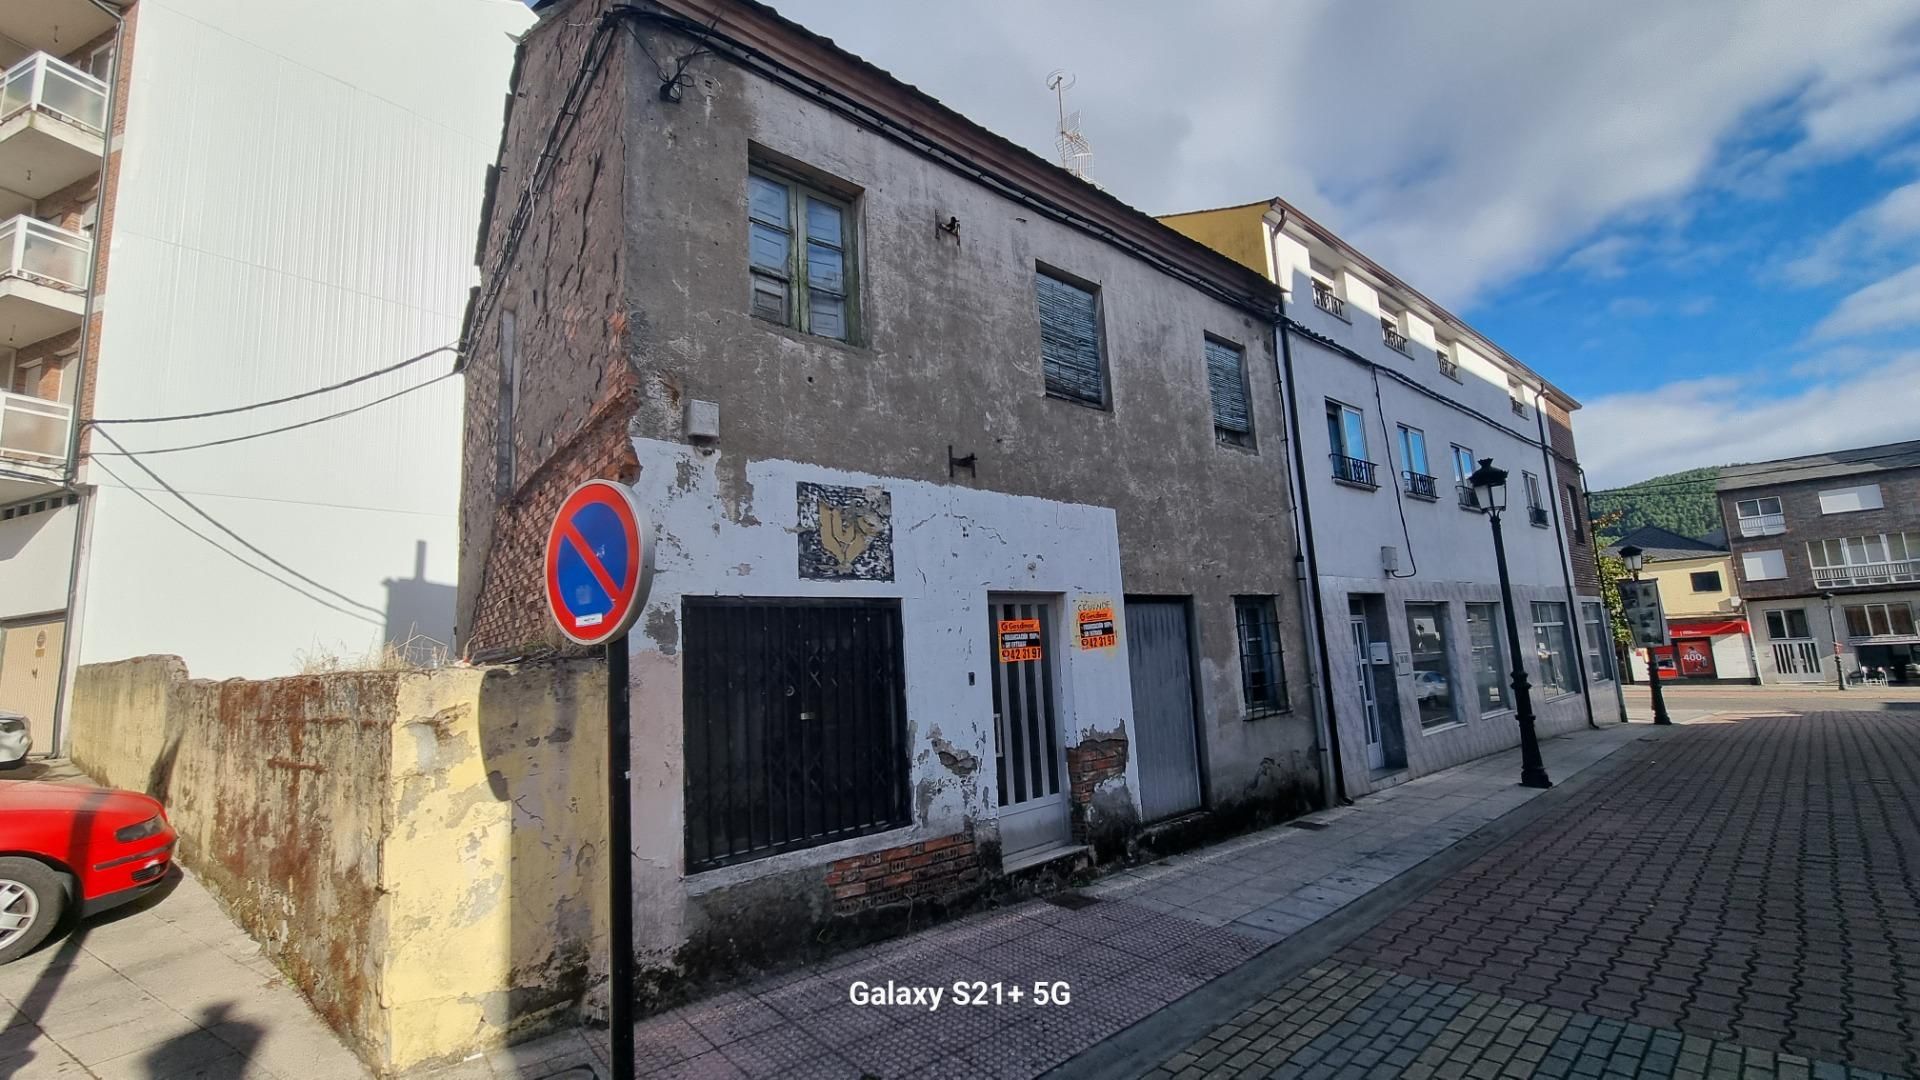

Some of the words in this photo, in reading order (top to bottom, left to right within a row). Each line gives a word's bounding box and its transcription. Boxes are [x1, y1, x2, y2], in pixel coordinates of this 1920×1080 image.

[1011, 648, 1020, 660] 42
[1022, 648, 1030, 659] 31
[1031, 647, 1041, 659] 97
